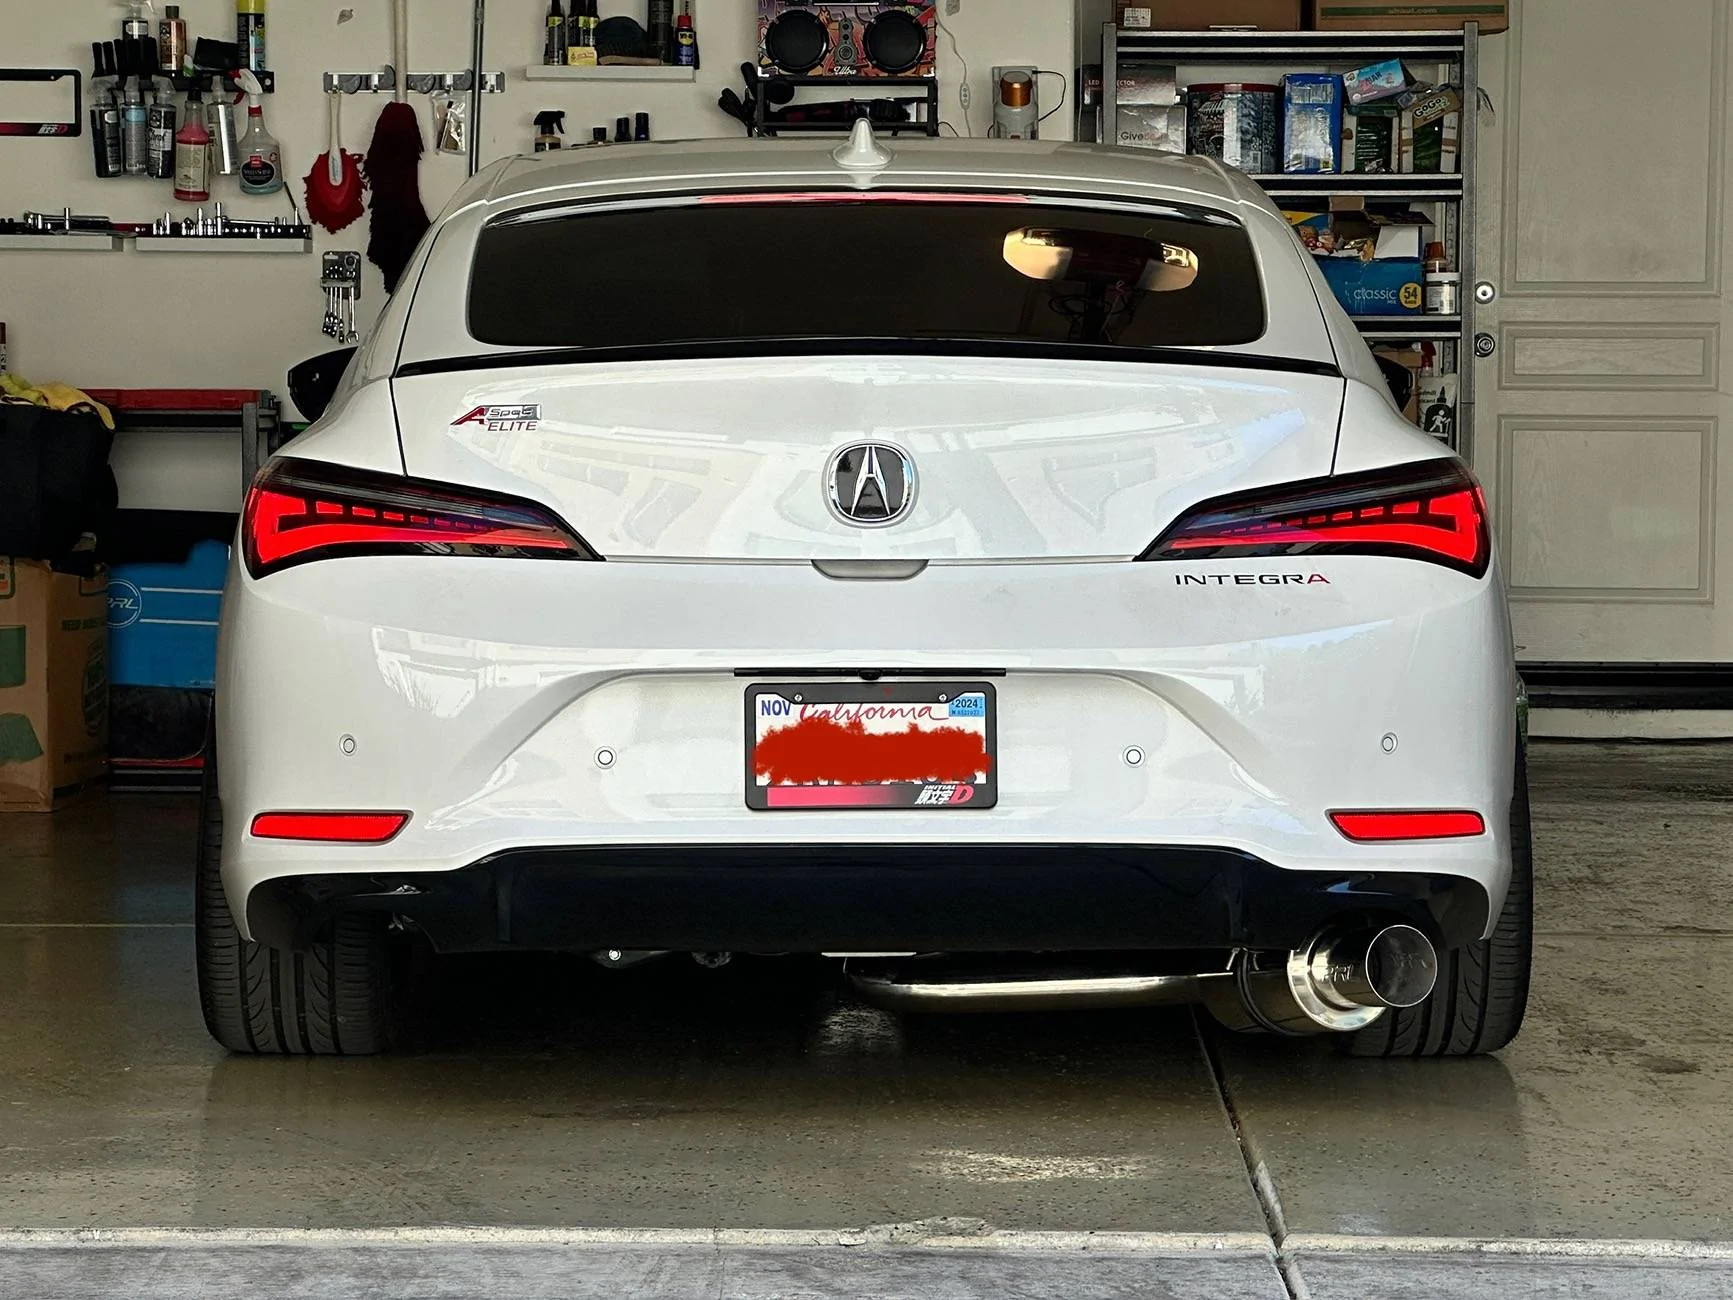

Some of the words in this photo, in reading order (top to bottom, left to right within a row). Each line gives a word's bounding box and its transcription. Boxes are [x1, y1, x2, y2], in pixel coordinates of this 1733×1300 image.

[1354, 288, 1397, 299] classic
[1404, 287, 1418, 300] 54
[487, 421, 537, 432] ELITE
[1175, 574, 1331, 585] INTEGRA
[761, 700, 791, 717] NOV
[800, 703, 950, 722] California
[955, 698, 979, 709] 2024
